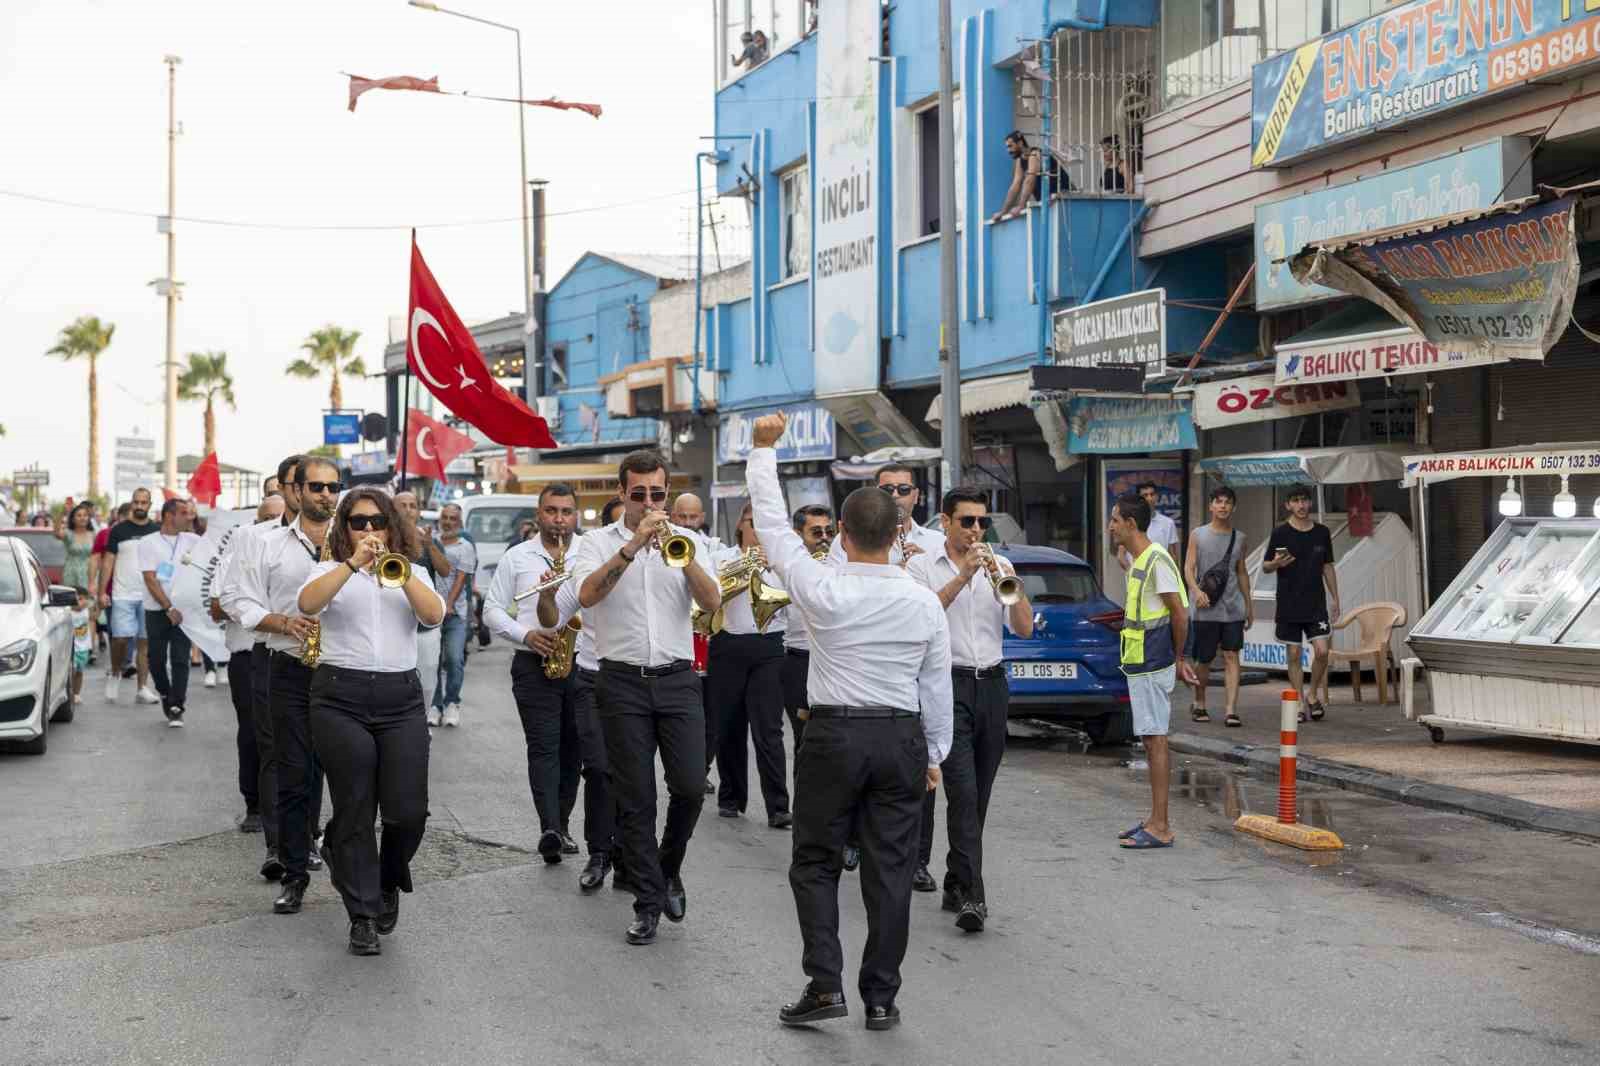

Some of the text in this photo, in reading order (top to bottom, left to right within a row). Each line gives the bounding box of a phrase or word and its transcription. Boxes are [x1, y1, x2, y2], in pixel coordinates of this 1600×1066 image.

[1491, 41, 1543, 84] 0536
[1548, 26, 1588, 66] 684
[1324, 60, 1478, 139] Balık Restaurant
[822, 159, 870, 225] İNCİLİ
[817, 235, 875, 281] RESTAURANT
[1073, 301, 1160, 346] ÖZCAN BALIKÇILIK
[1434, 314, 1475, 336] 0507
[1478, 315, 1511, 338] 132
[1512, 313, 1534, 338] 39
[1303, 349, 1366, 378] BALIKÇI
[1216, 381, 1348, 413] ÖZCAN
[1419, 460, 1456, 473] AKAR
[1458, 456, 1535, 473] BALIKÇILIK
[1541, 455, 1565, 469] 0507
[1568, 455, 1585, 468] 132
[1013, 664, 1025, 677] 33
[1060, 664, 1072, 677] 35
